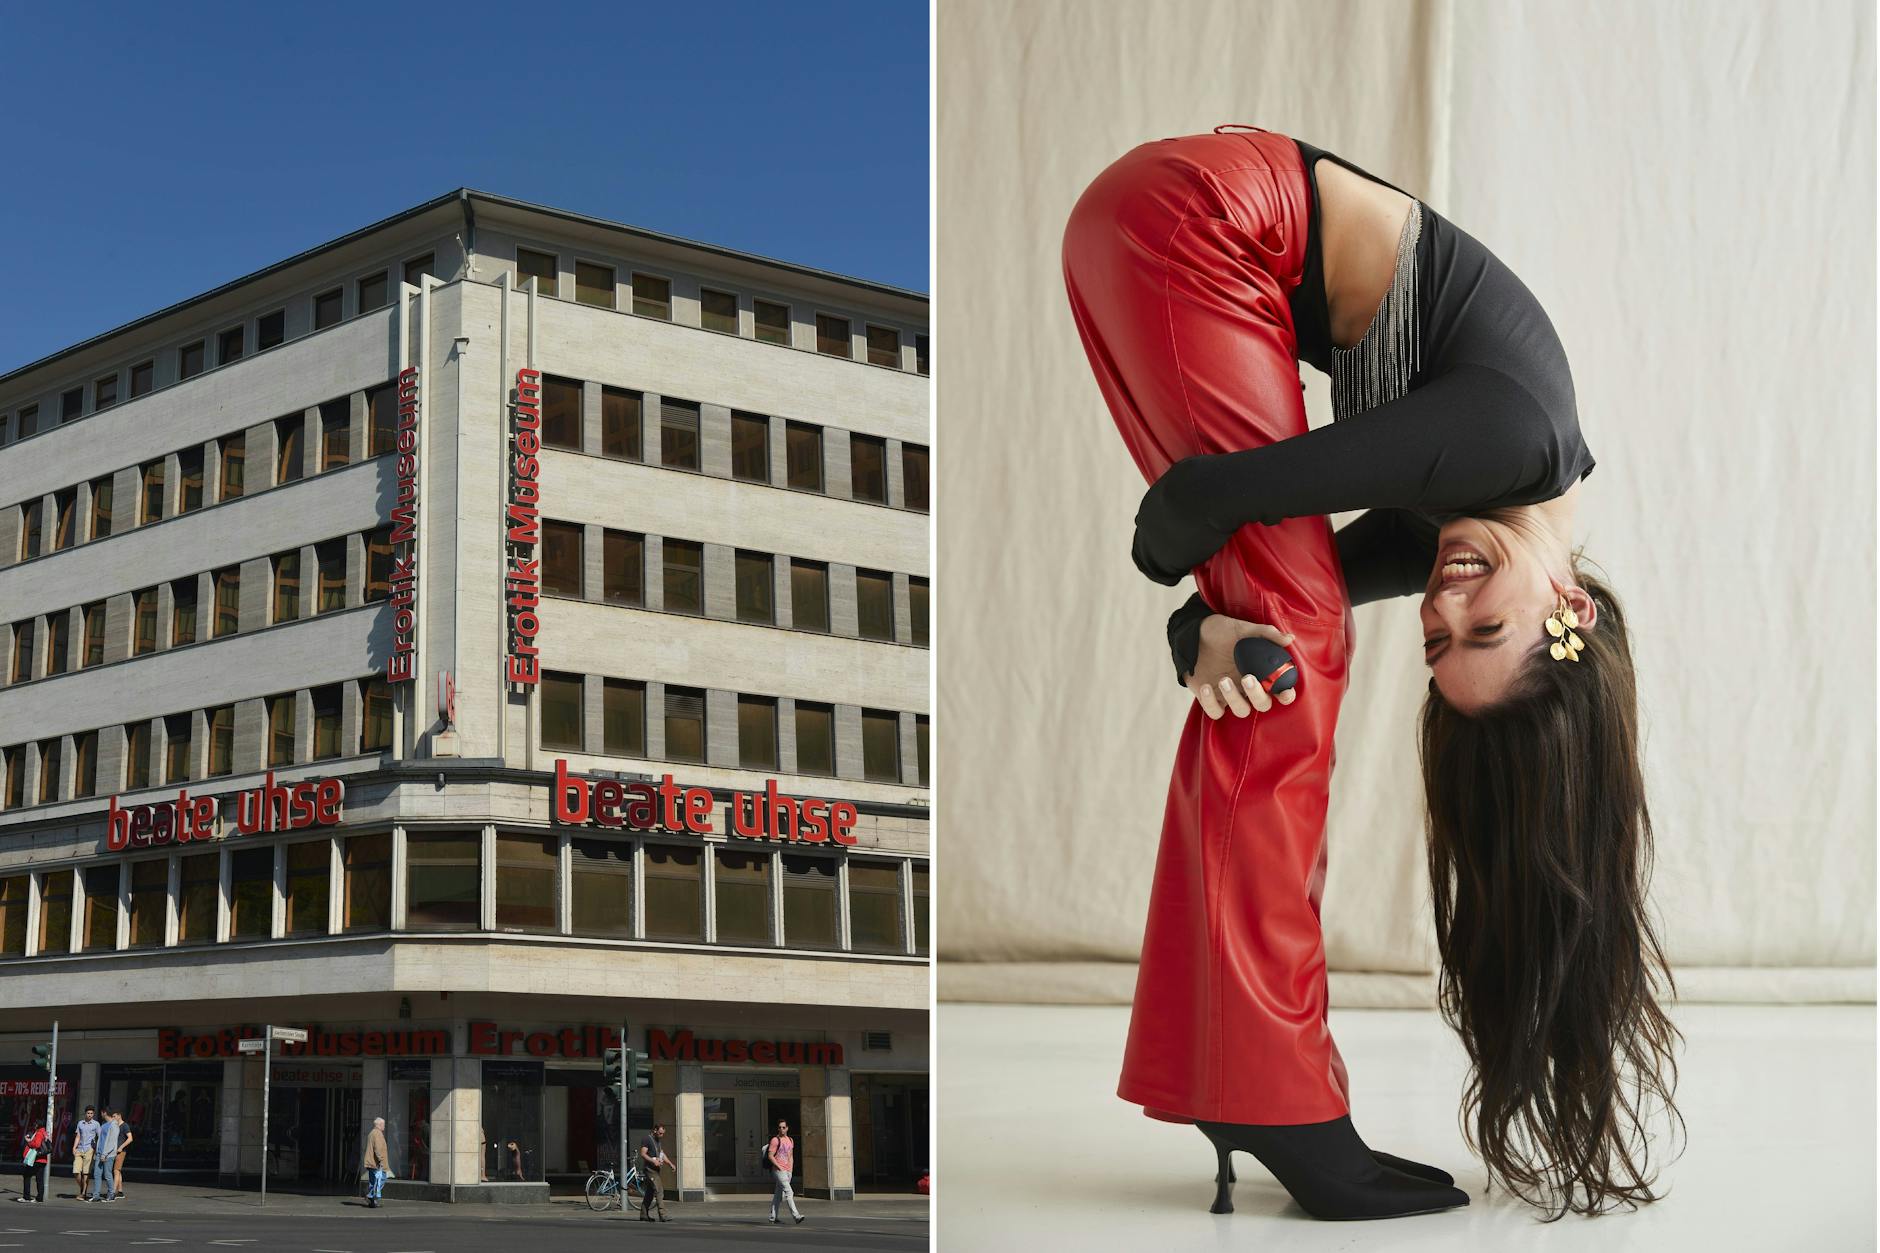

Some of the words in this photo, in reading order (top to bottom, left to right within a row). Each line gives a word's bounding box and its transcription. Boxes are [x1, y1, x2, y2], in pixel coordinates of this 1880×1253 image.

[390, 366, 418, 545] Museum
[507, 367, 540, 544] Museum
[387, 552, 416, 683] Erotik
[507, 558, 540, 684] Erotik
[107, 789, 218, 851] beate
[236, 771, 345, 835] uhse
[554, 759, 714, 833] beate
[733, 779, 858, 845] uhse
[15, 1082, 29, 1095] 70%
[31, 1082, 67, 1095] REDUERT
[650, 1028, 844, 1065] Museum
